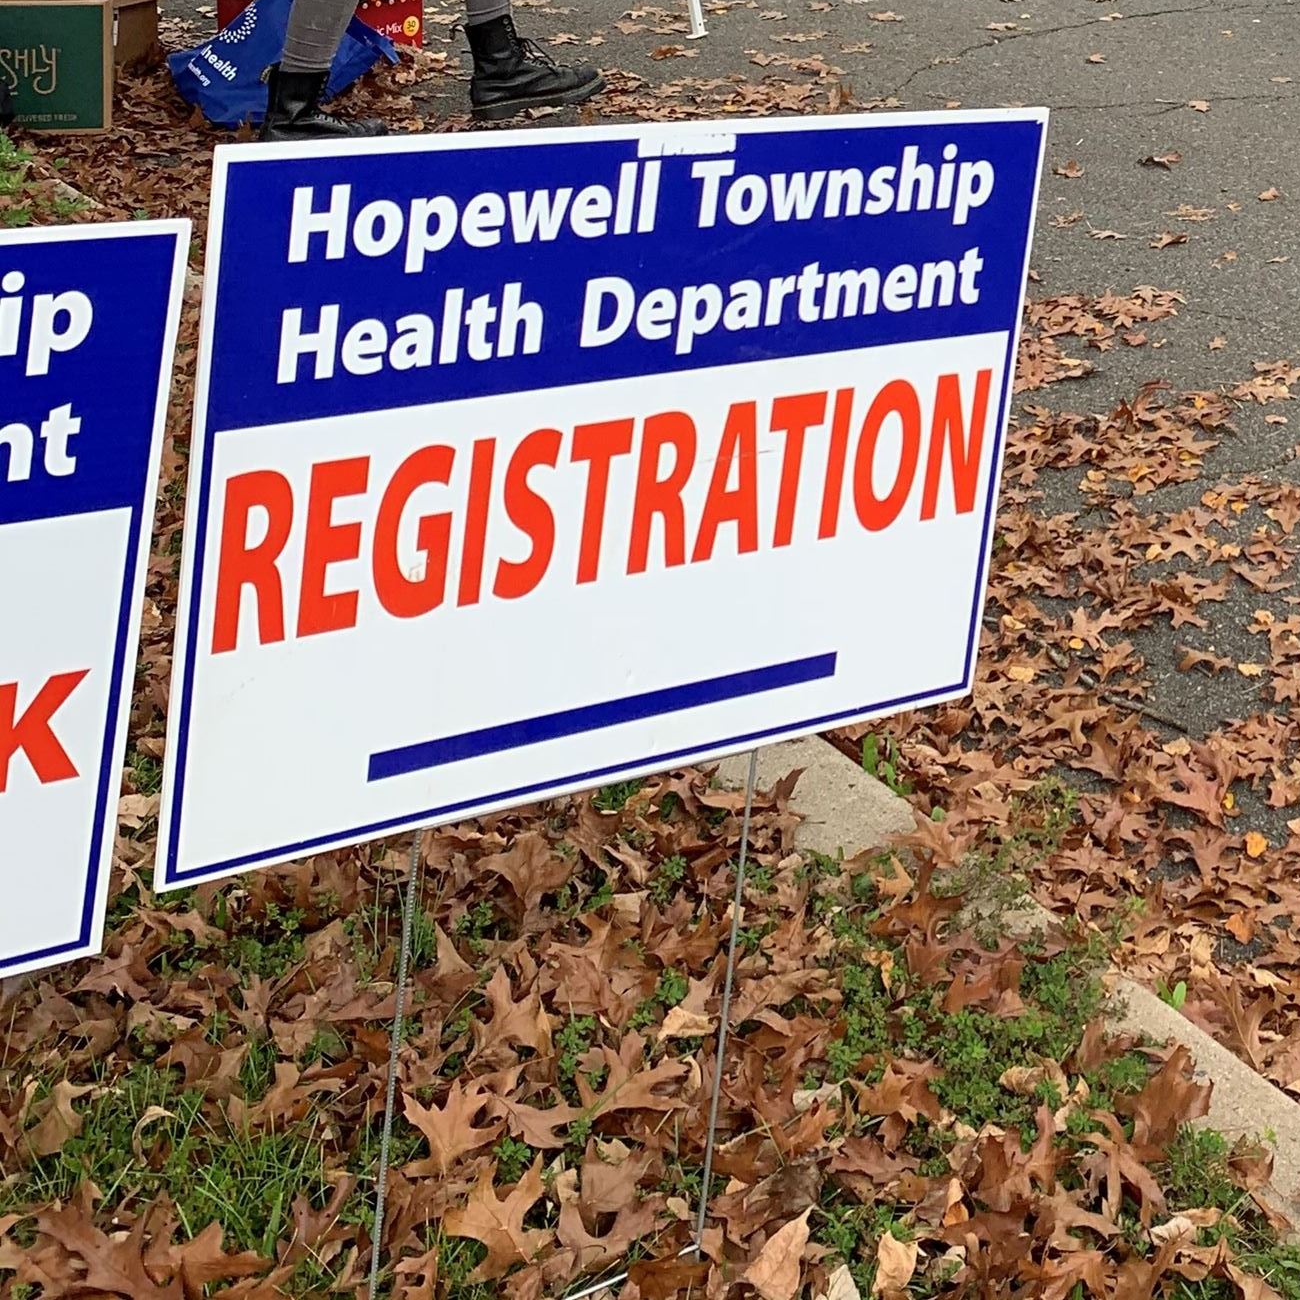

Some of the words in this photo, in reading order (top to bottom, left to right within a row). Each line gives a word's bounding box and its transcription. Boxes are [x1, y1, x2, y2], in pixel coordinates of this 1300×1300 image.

[386, 22, 402, 35] Mix
[287, 161, 662, 274] Hopewell
[691, 145, 995, 228] Township
[276, 282, 544, 384] Health
[579, 247, 984, 357] Department
[211, 369, 992, 654] REGISTRATION
